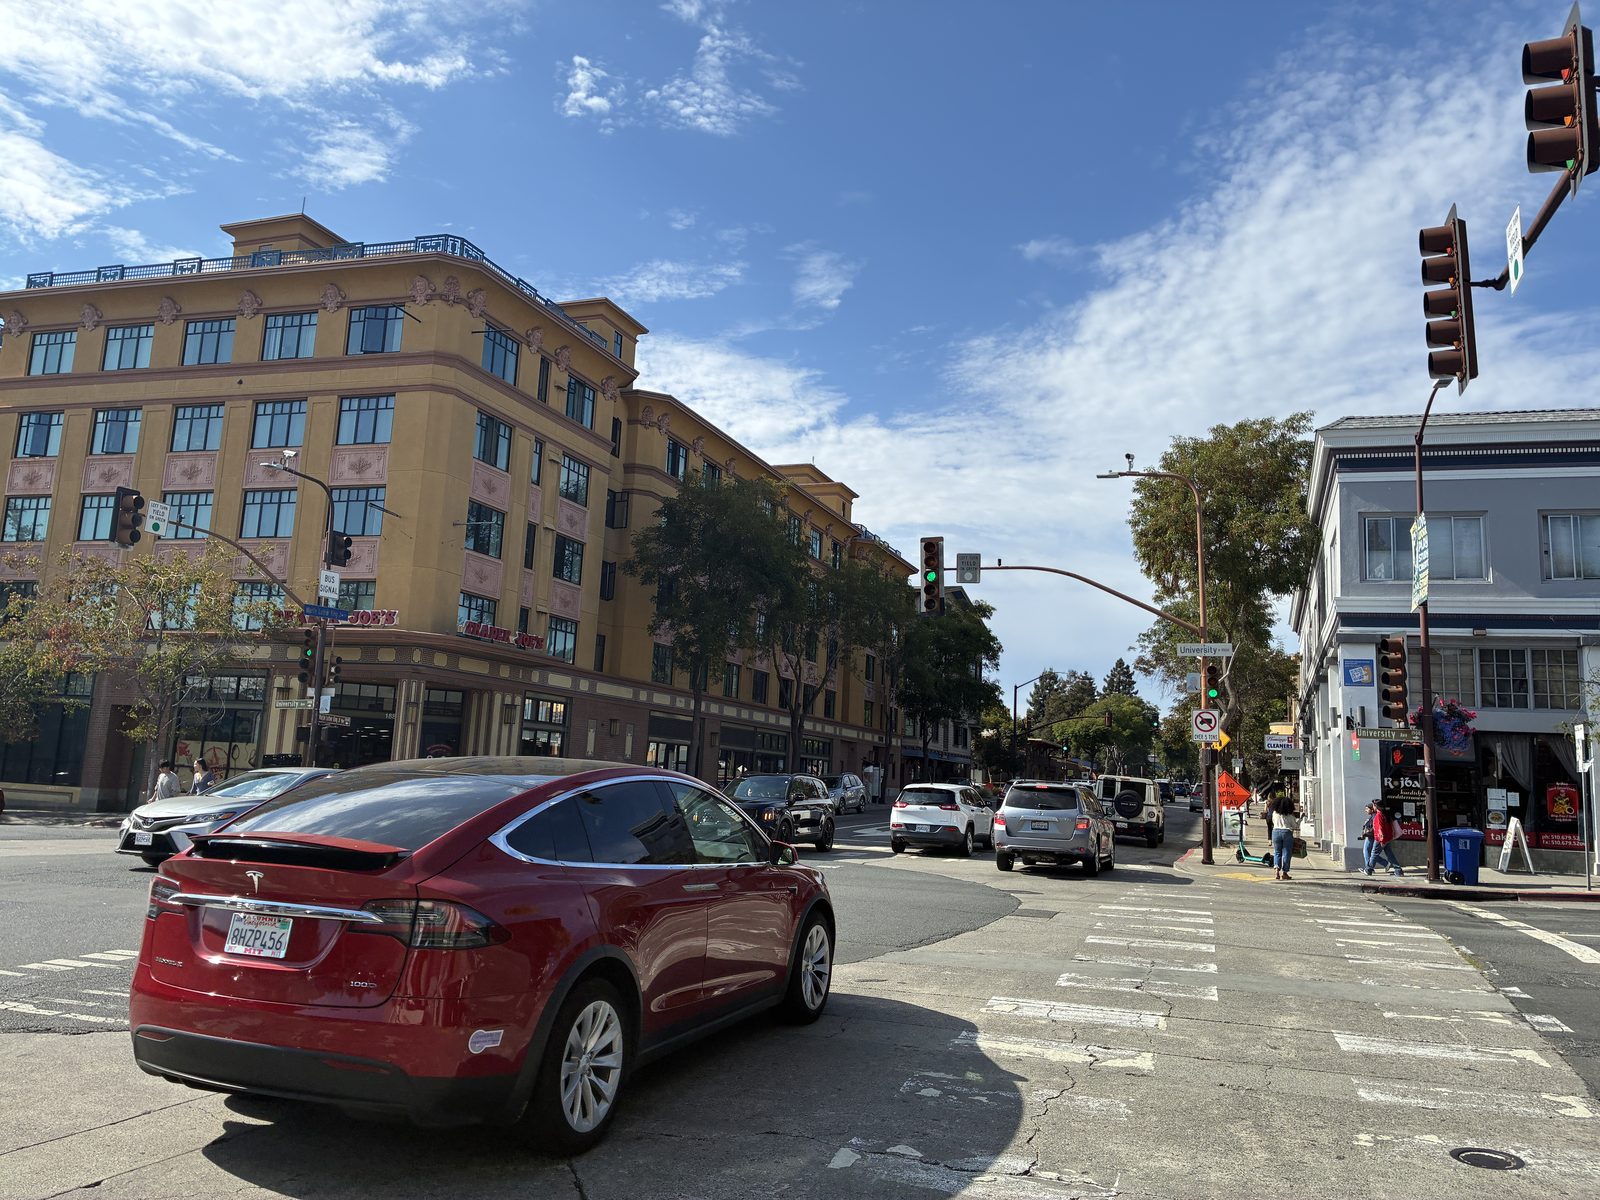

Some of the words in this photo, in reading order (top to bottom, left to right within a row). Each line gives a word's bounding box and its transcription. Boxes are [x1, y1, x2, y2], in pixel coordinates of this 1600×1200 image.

[324, 574, 335, 583] BUS
[320, 584, 338, 595] SIGNAL
[348, 610, 397, 625] JOE'S
[464, 620, 512, 642] TRADER
[1180, 646, 1217, 654] University
[1357, 728, 1396, 738] University
[1402, 827, 1424, 838] ering
[1490, 832, 1530, 842] takot
[230, 927, 285, 951] 8HZP456
[243, 947, 263, 955] MIT
